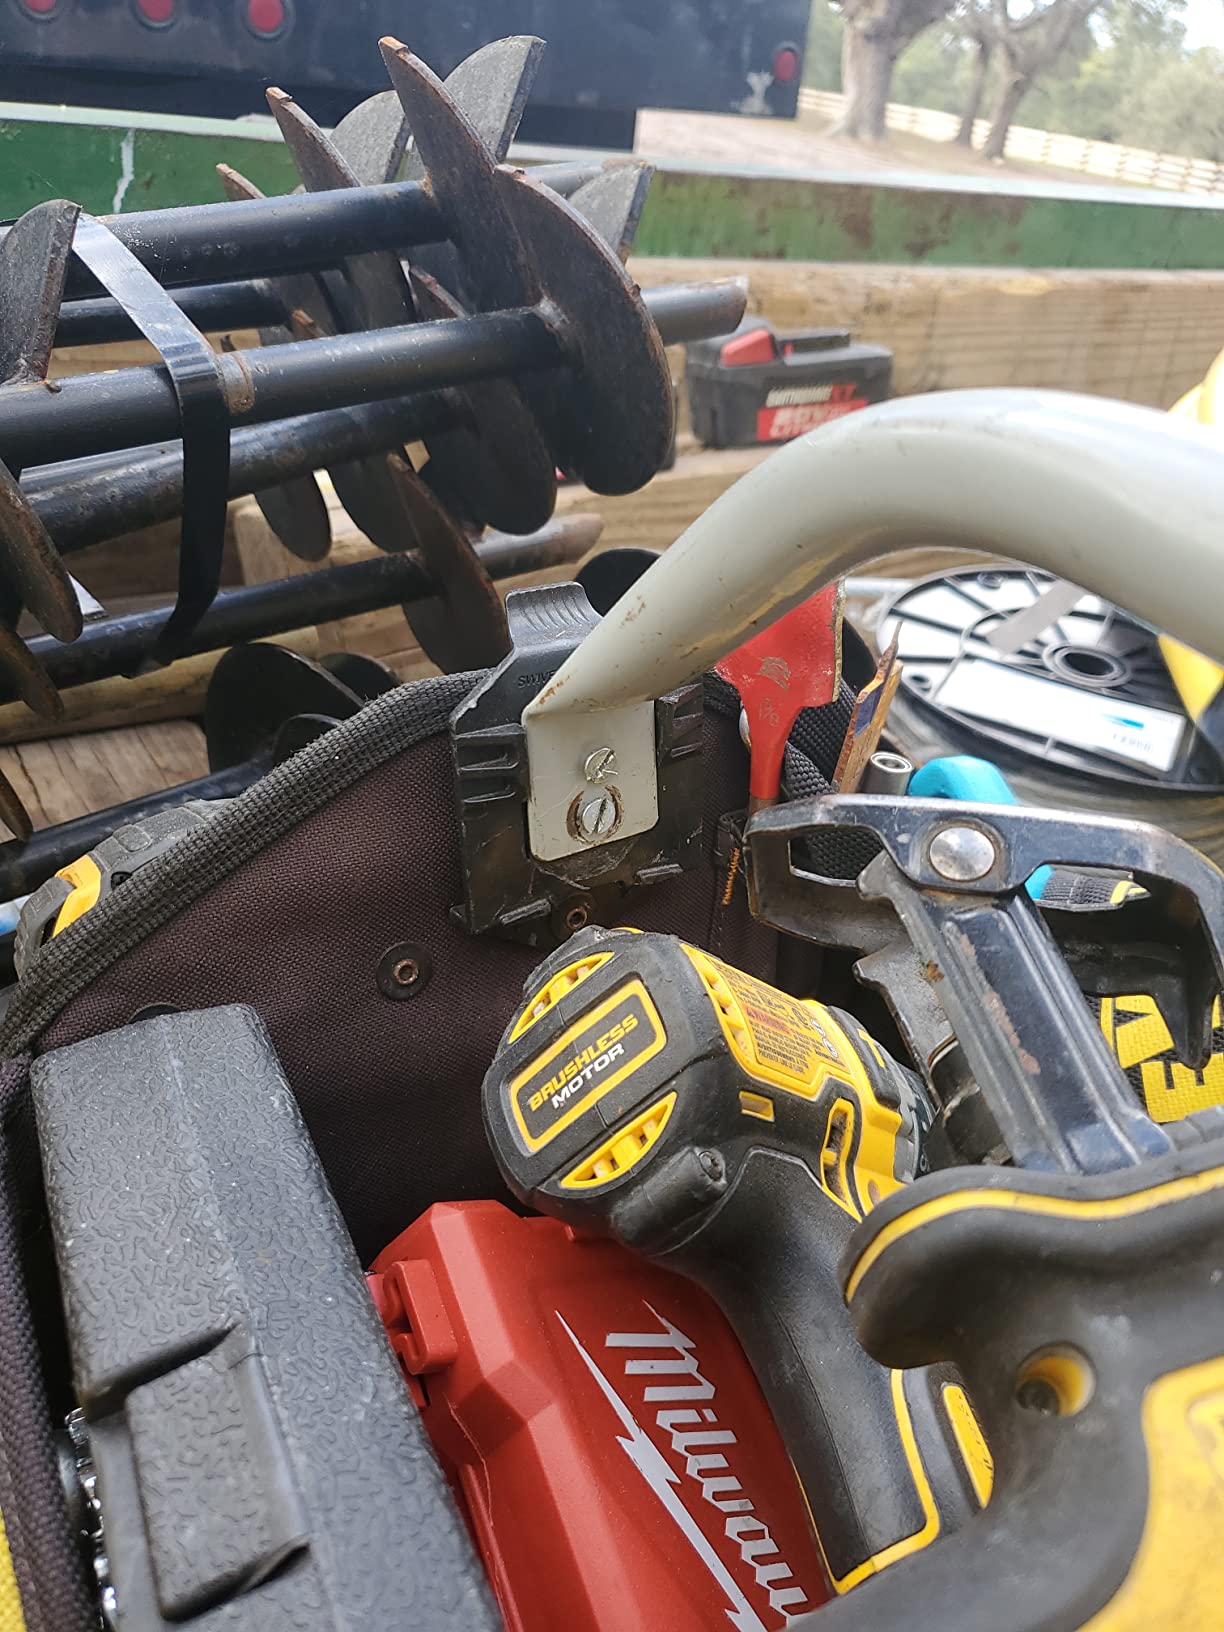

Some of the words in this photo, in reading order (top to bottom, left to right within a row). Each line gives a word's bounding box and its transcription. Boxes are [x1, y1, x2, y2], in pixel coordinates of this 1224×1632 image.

[528, 1013, 639, 1112] BRUSHLESS
[551, 1042, 625, 1109] MOTOR
[605, 1300, 809, 1630] Milwau
